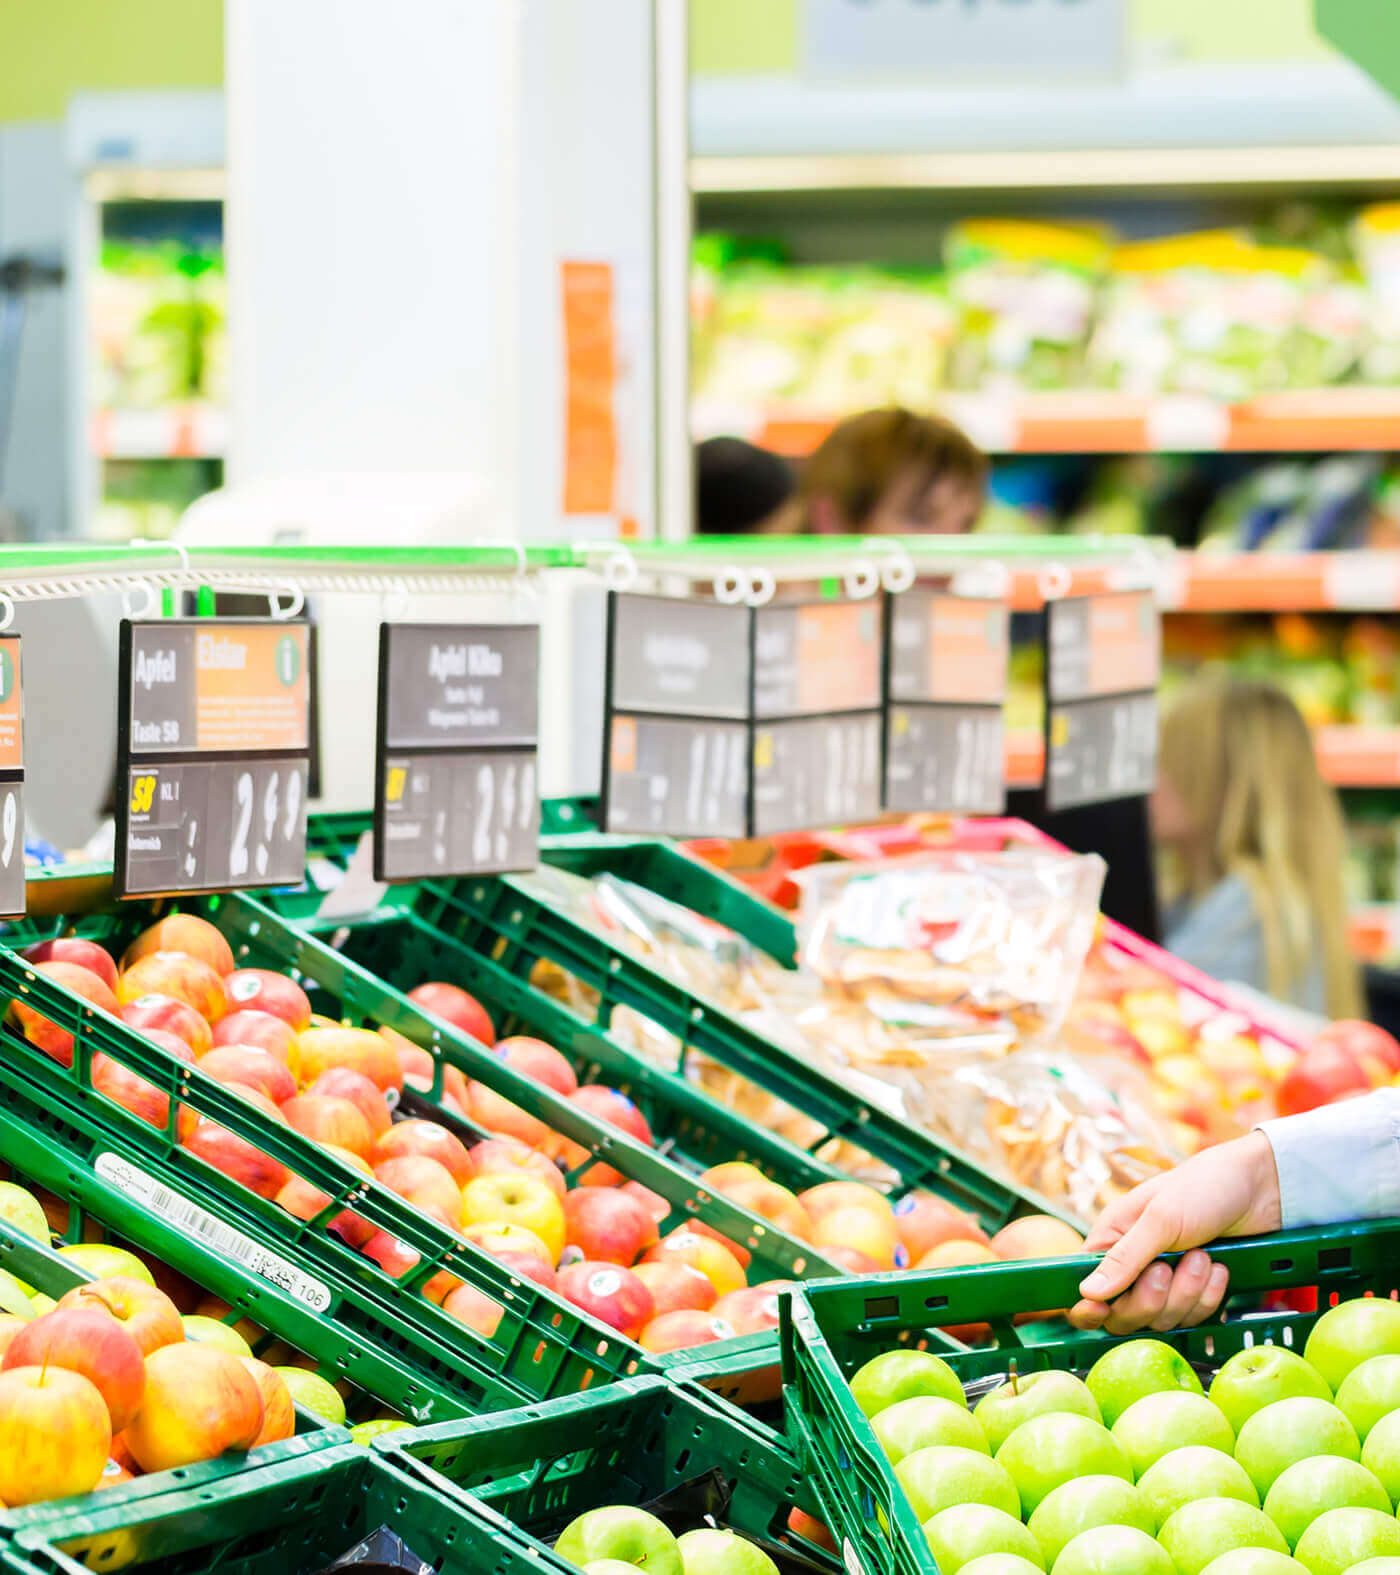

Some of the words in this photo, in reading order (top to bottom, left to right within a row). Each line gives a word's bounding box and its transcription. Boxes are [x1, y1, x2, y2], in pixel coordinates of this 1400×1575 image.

[136, 649, 176, 690] Apfel
[429, 644, 466, 683] Apfel
[133, 720, 161, 743] Taste
[299, 1284, 325, 1306] 106
